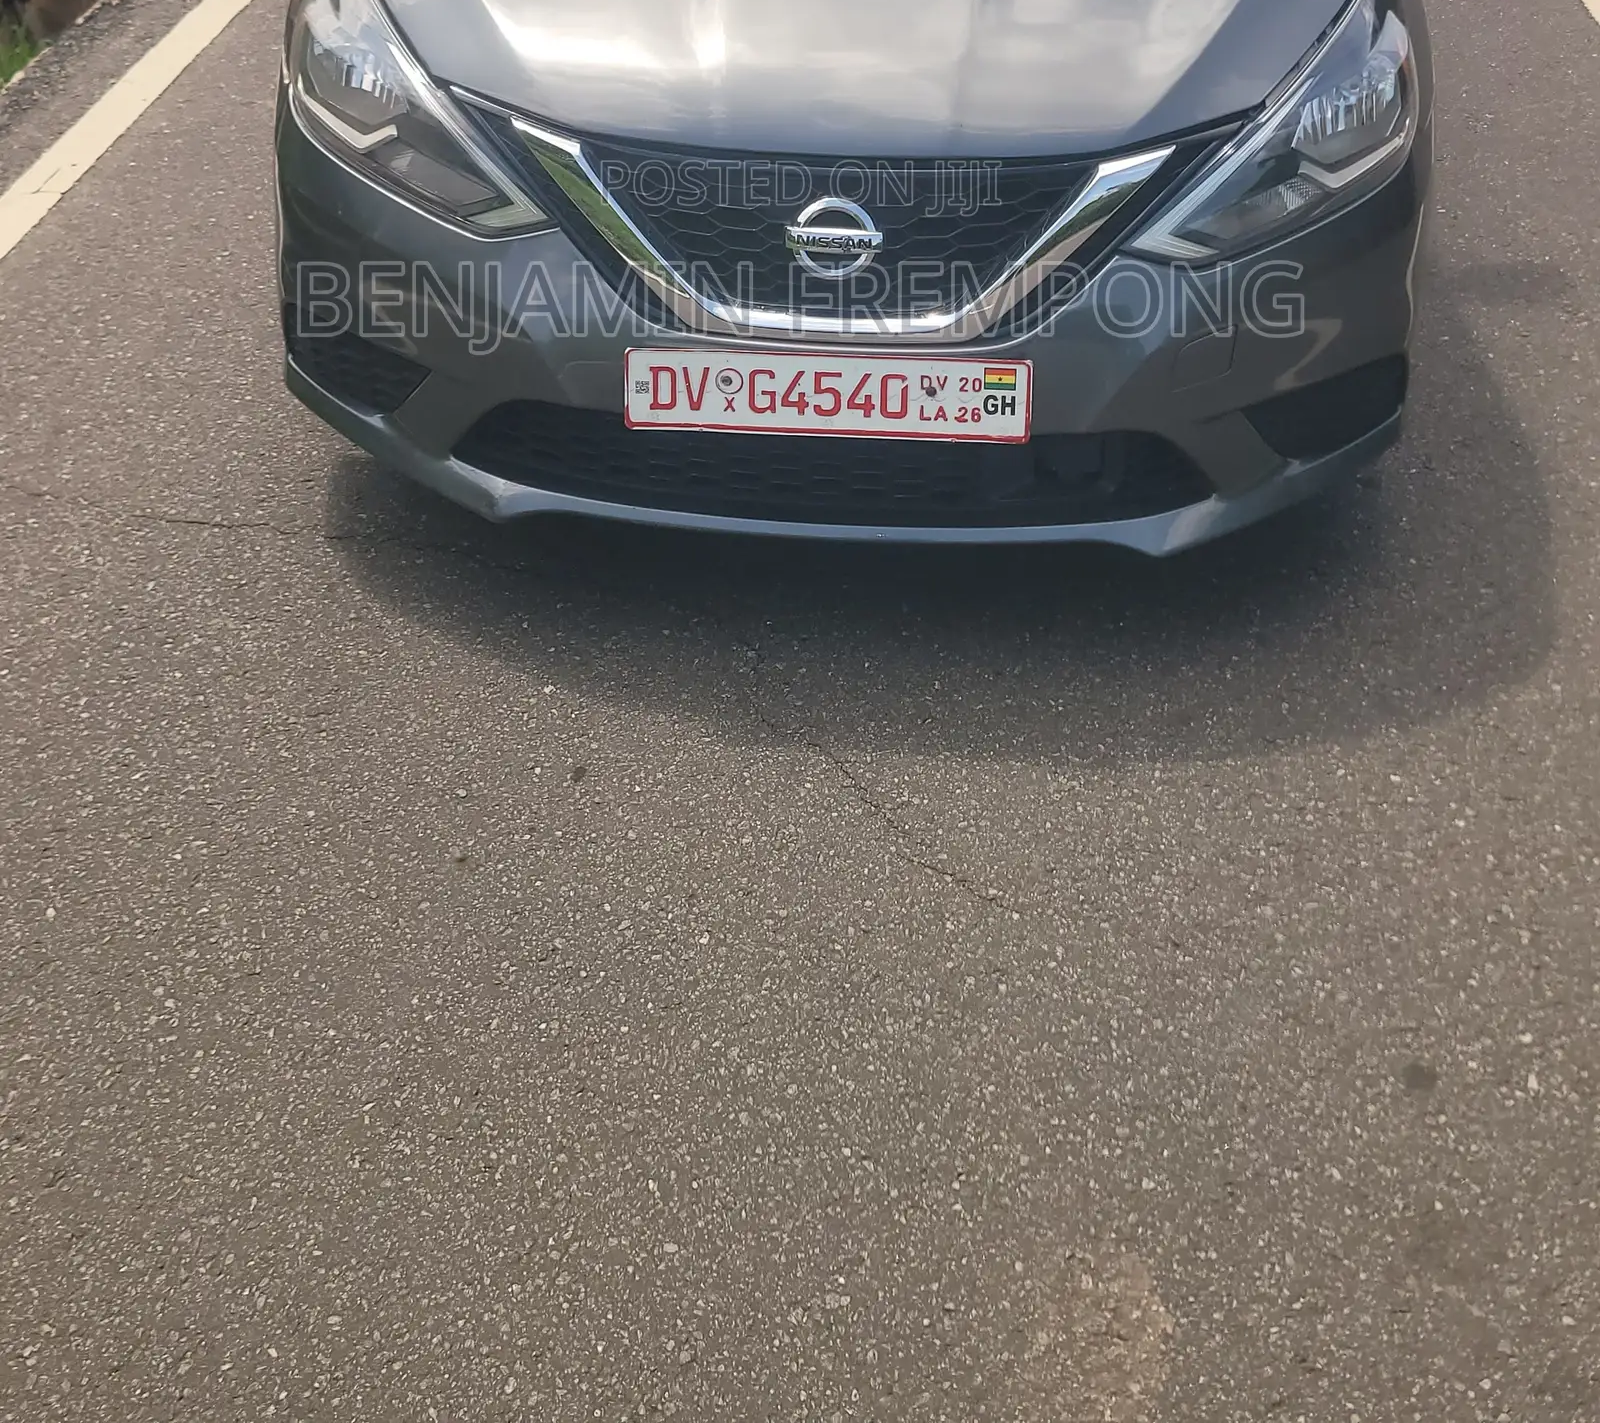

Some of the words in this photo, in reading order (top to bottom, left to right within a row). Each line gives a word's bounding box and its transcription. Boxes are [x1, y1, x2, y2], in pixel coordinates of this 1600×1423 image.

[795, 234, 872, 251] NISSAN
[649, 367, 710, 411] DV
[748, 369, 909, 419] G4540
[920, 375, 948, 391] DV
[959, 377, 982, 393] 20
[919, 405, 948, 421] LA
[983, 395, 1016, 416] GH
